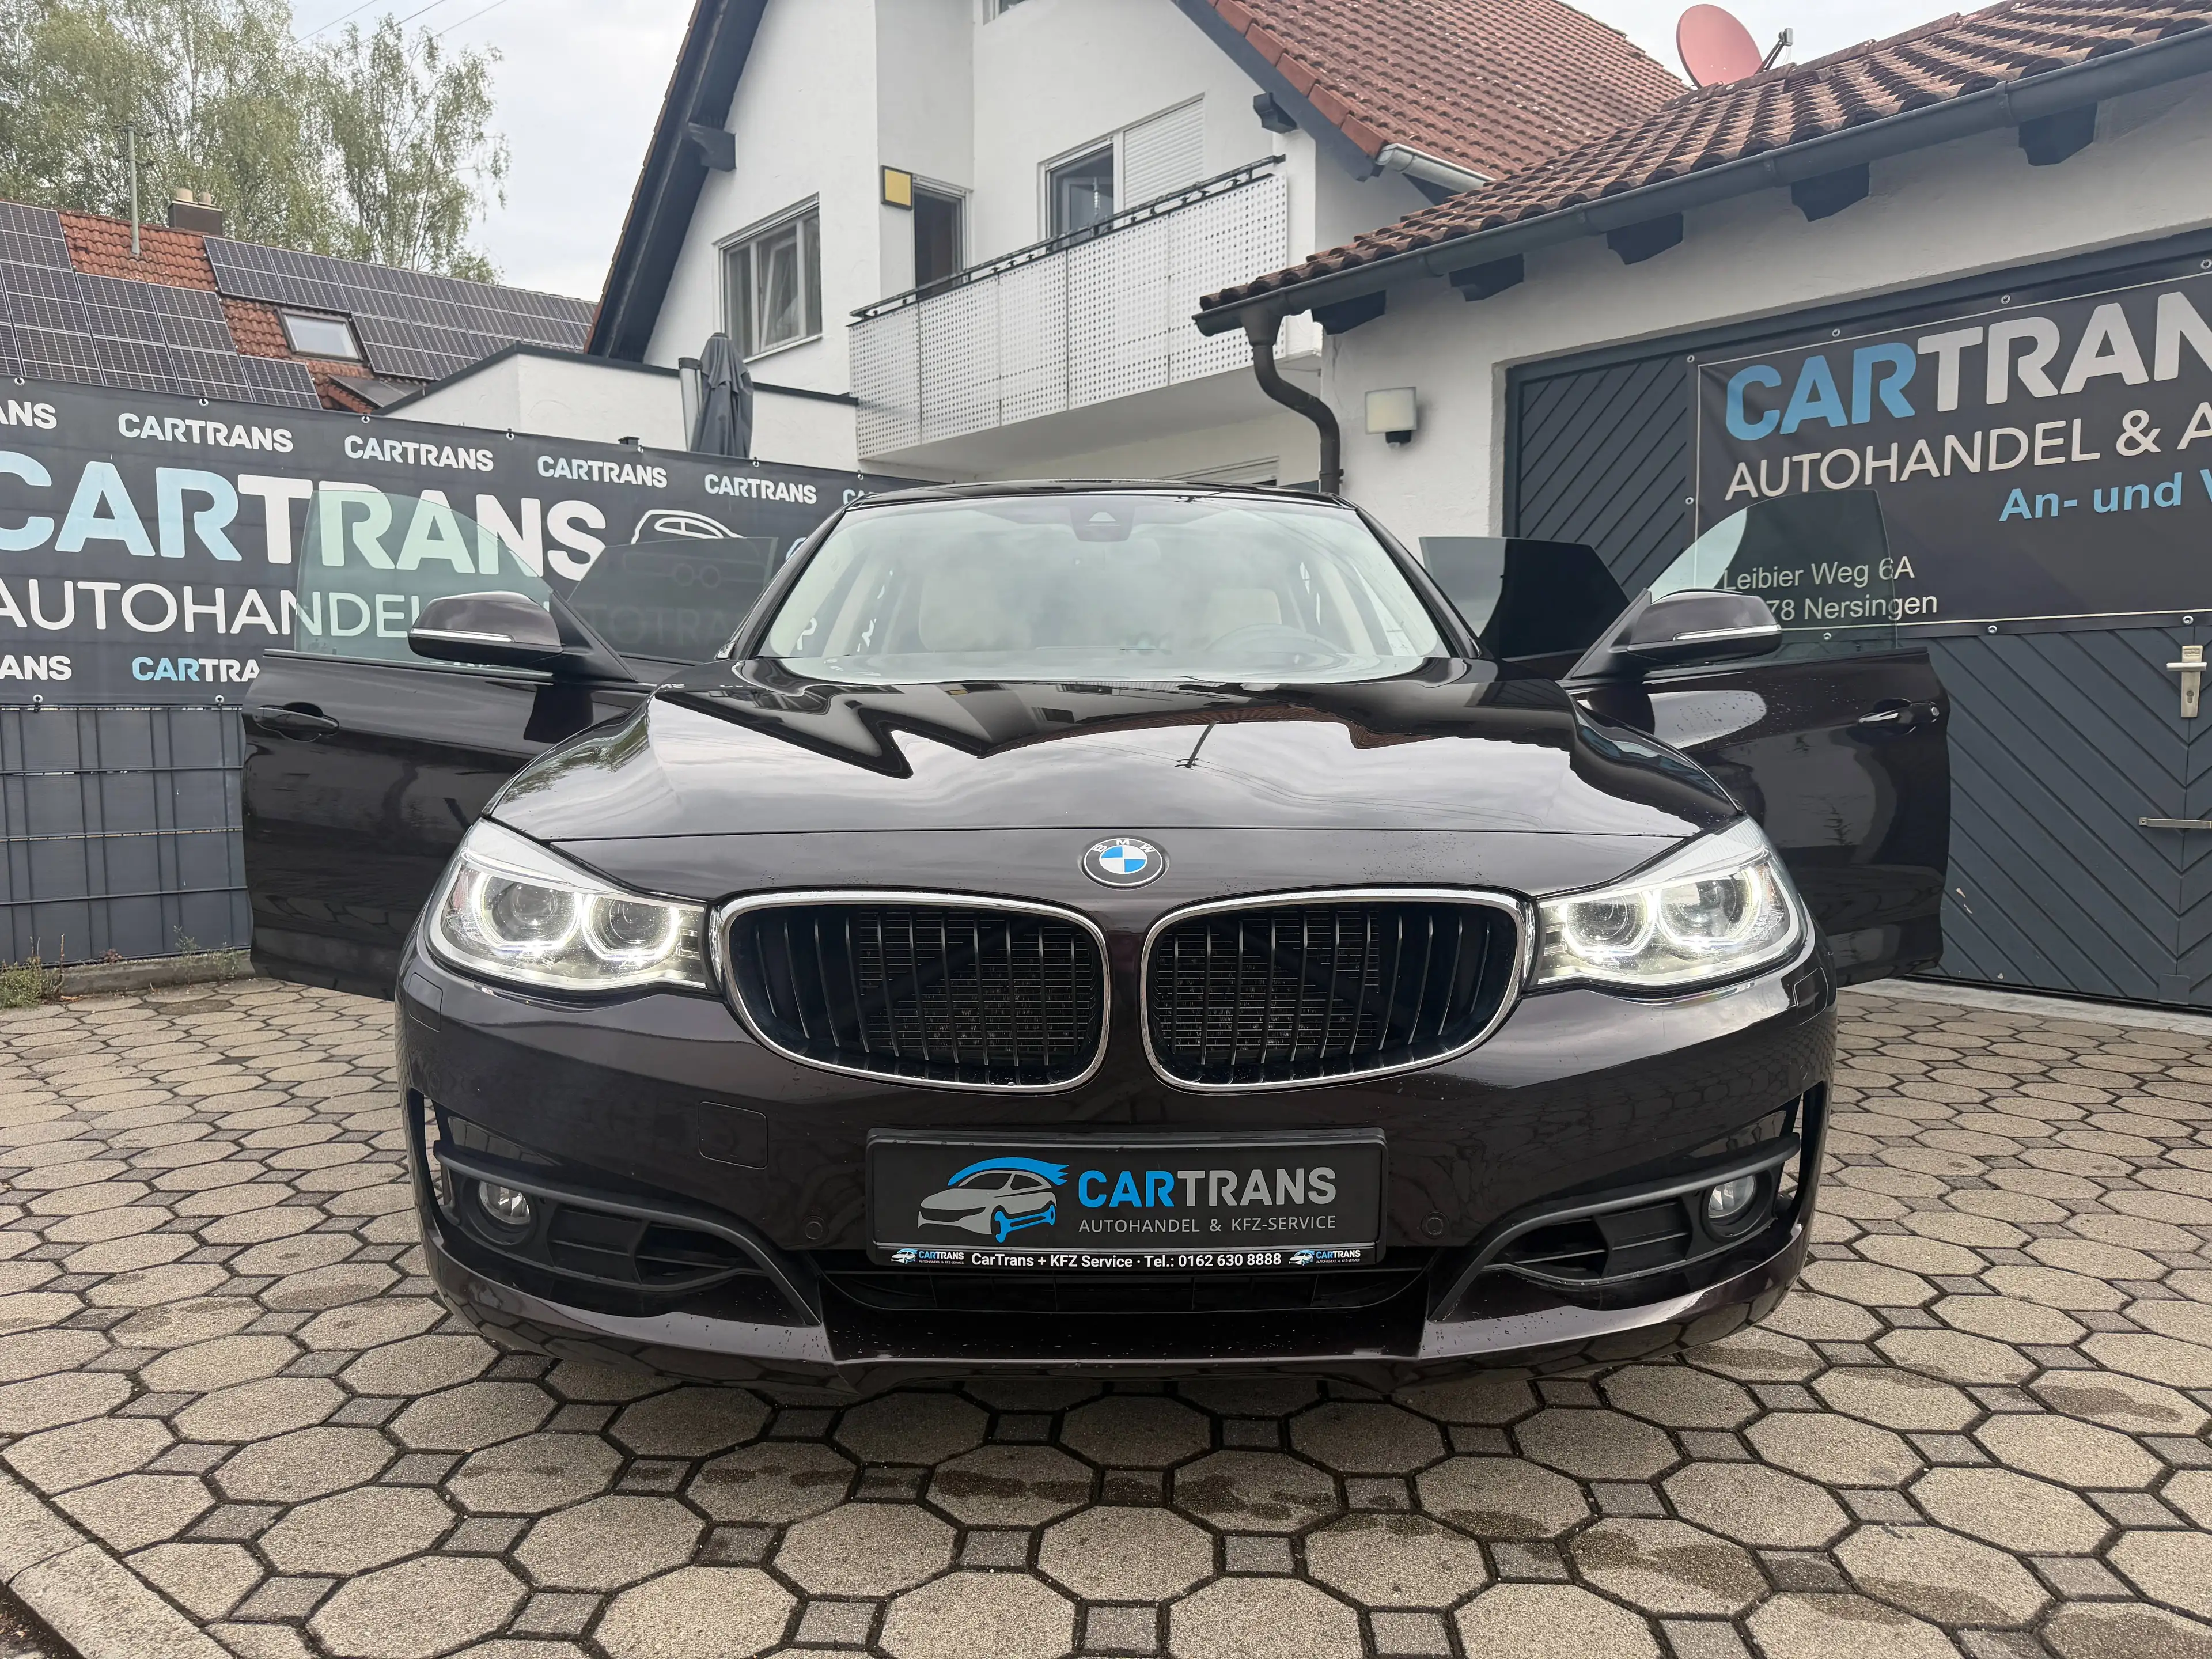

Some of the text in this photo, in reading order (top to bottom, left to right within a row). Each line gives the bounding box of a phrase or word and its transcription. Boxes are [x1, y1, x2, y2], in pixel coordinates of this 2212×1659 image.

[118, 412, 294, 453] CARTRANS
[345, 435, 494, 472] CARTRANS
[1725, 417, 2101, 501] AUTOHANDEL
[2116, 410, 2161, 456] &
[537, 455, 668, 488] CARTRANS
[704, 474, 817, 505] CARTRANS
[1998, 488, 2078, 522] An-
[2094, 472, 2183, 513] und
[0, 450, 607, 581] CARTRANS
[1723, 555, 1915, 590] Leibier Weg 6A
[1804, 594, 1938, 622] Nersingen
[1092, 839, 1156, 853] BMW
[1078, 1167, 1336, 1208] CARTRANS
[1078, 1215, 1336, 1233] AUTOHANDEL & KFZ-SERVICE
[918, 1251, 965, 1260] CARTRANS
[971, 1253, 1035, 1266] CarTrans
[1037, 1256, 1047, 1266] +
[1050, 1255, 1078, 1267] KFZ
[1081, 1255, 1133, 1268] Service
[1143, 1255, 1175, 1267] Tel.:
[1178, 1255, 1213, 1267] 0162
[1217, 1254, 1243, 1267] 630
[1247, 1253, 1282, 1266] 8888
[1316, 1249, 1361, 1259] CARTRANS
